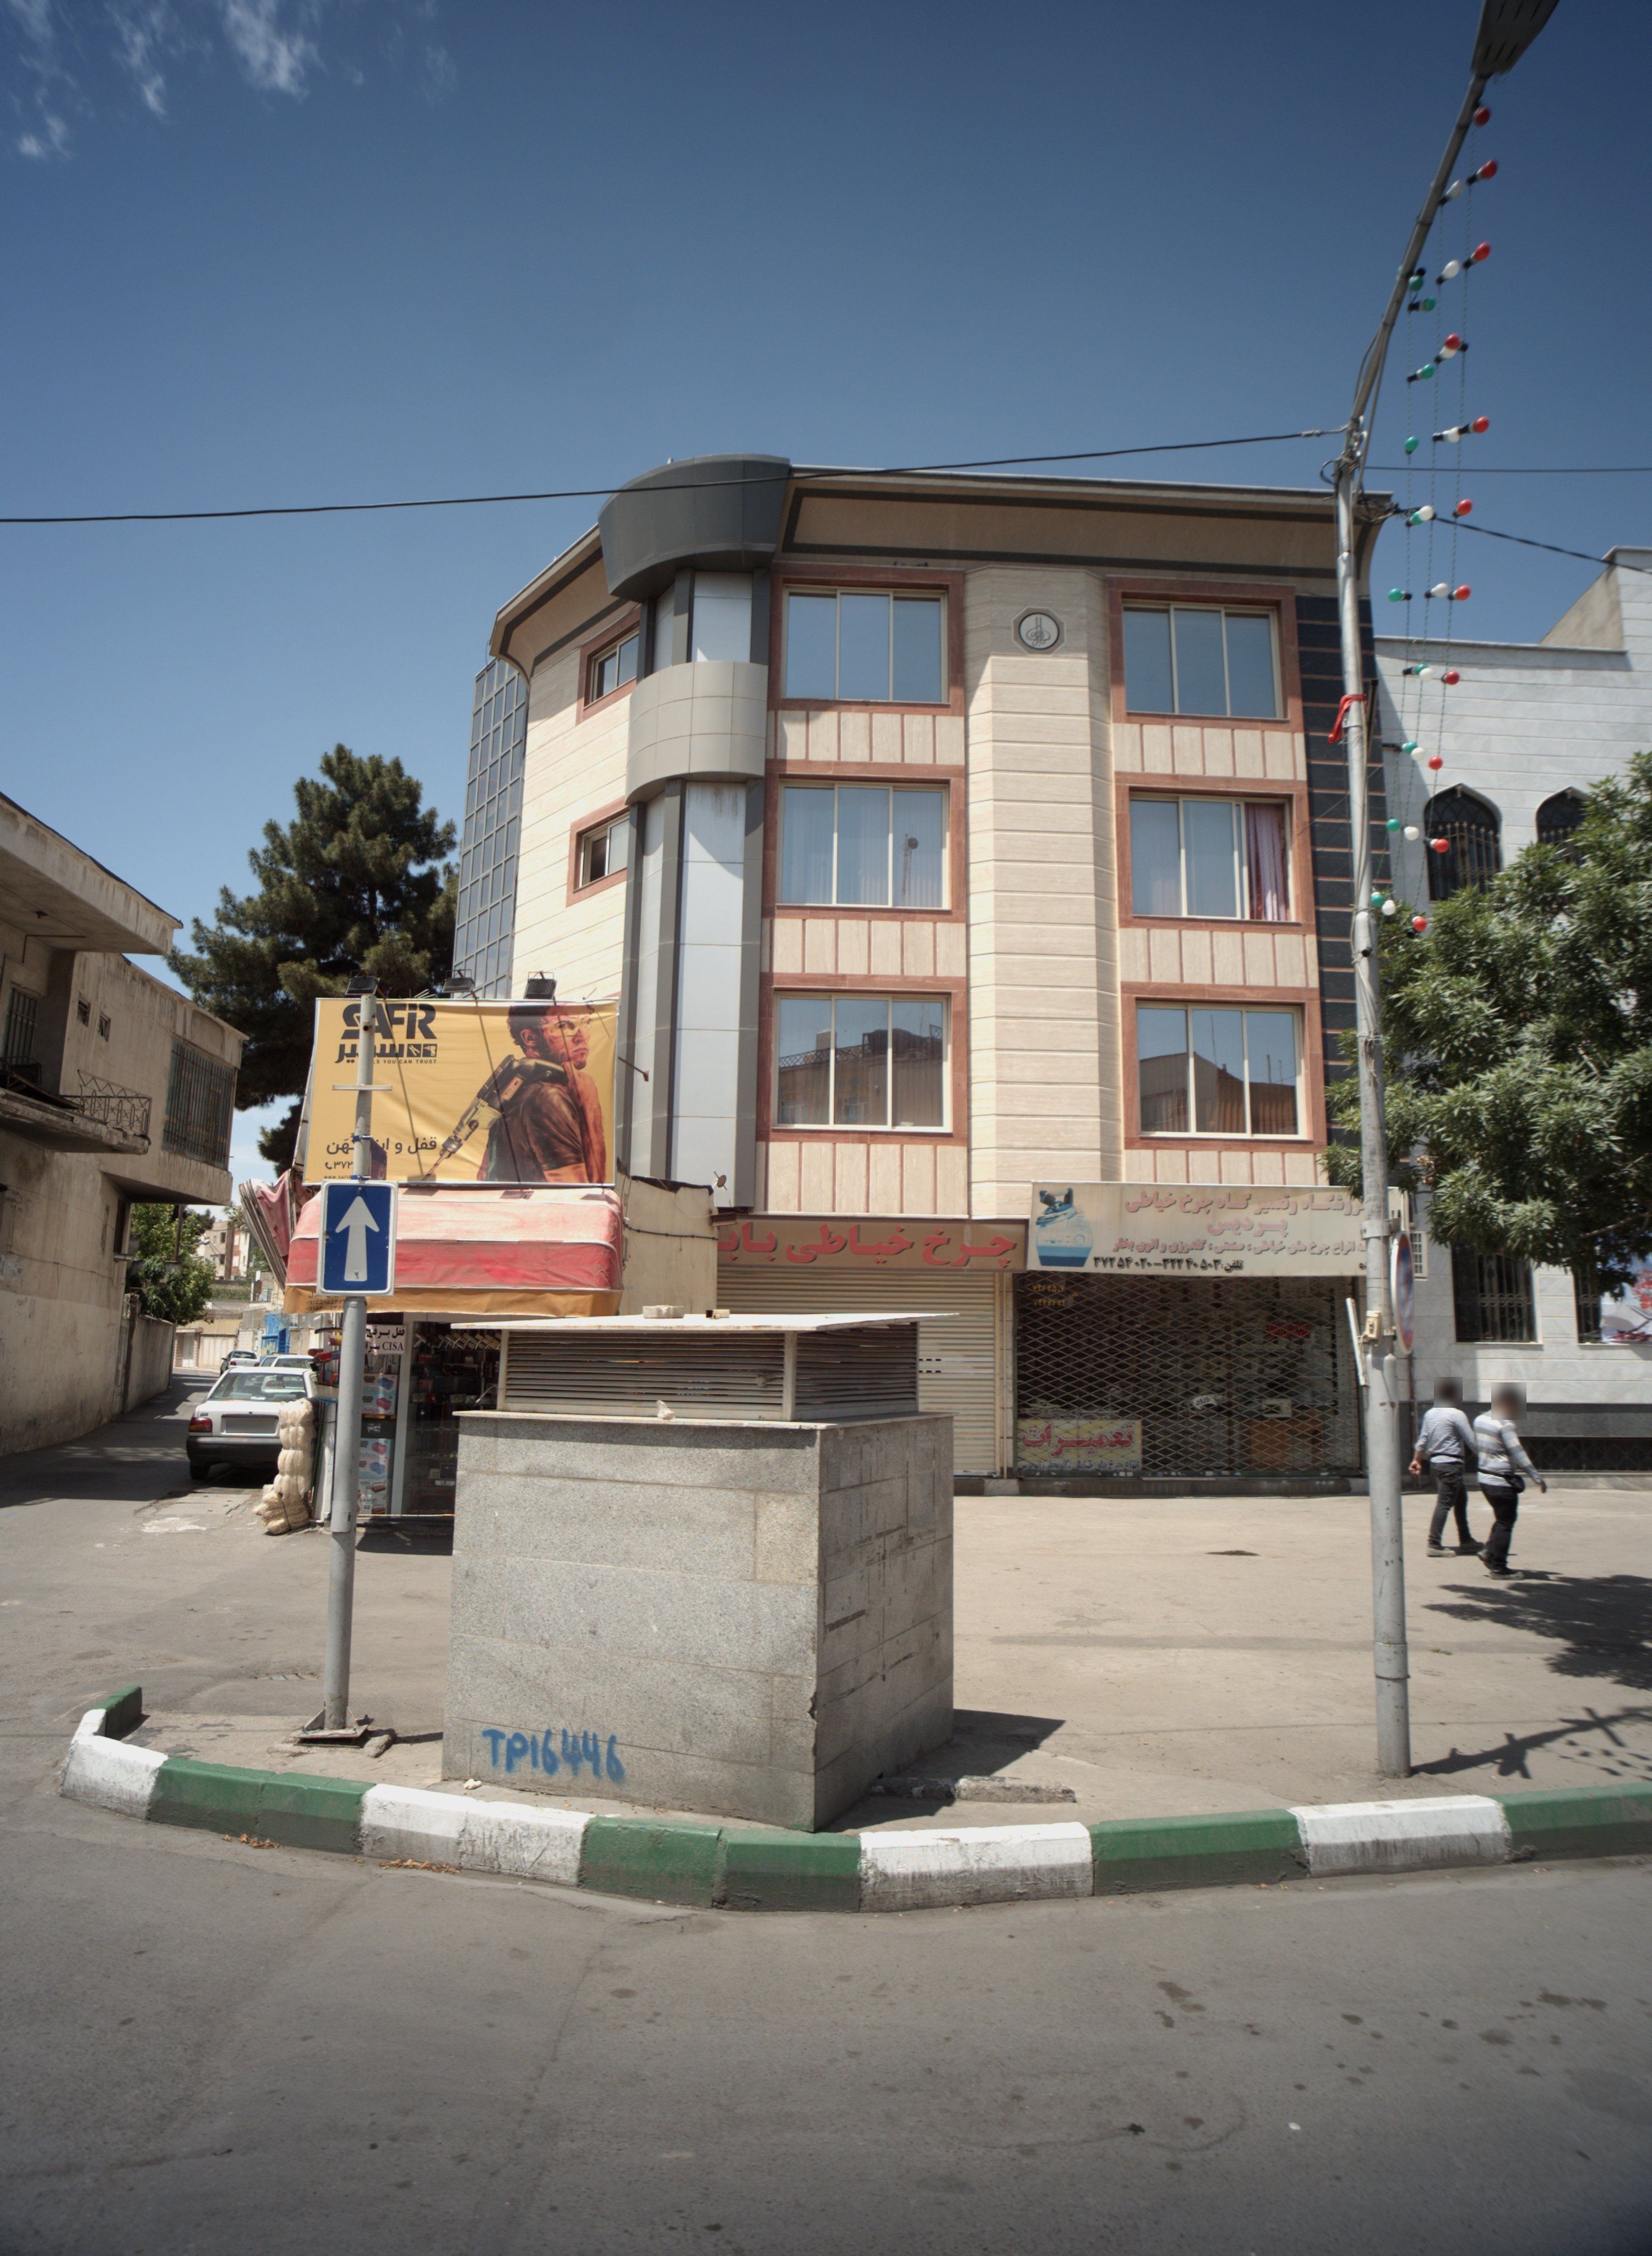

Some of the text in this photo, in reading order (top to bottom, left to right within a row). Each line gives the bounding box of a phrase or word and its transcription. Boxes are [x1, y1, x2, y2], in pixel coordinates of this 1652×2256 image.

[395, 1141, 403, 1154] و
[407, 1136, 437, 1154] قفل
[1125, 1190, 1177, 1212] خیاطی
[1180, 1194, 1214, 1214] چرخ
[1207, 1216, 1289, 1238] پردیس
[785, 1223, 915, 1263] خیاطی
[922, 1228, 1018, 1268] چرخ
[392, 1326, 405, 1338] قفل
[382, 1341, 404, 1351] CISA
[1021, 1421, 1135, 1457] تعمیرات
[482, 1728, 625, 1784] TP16446
